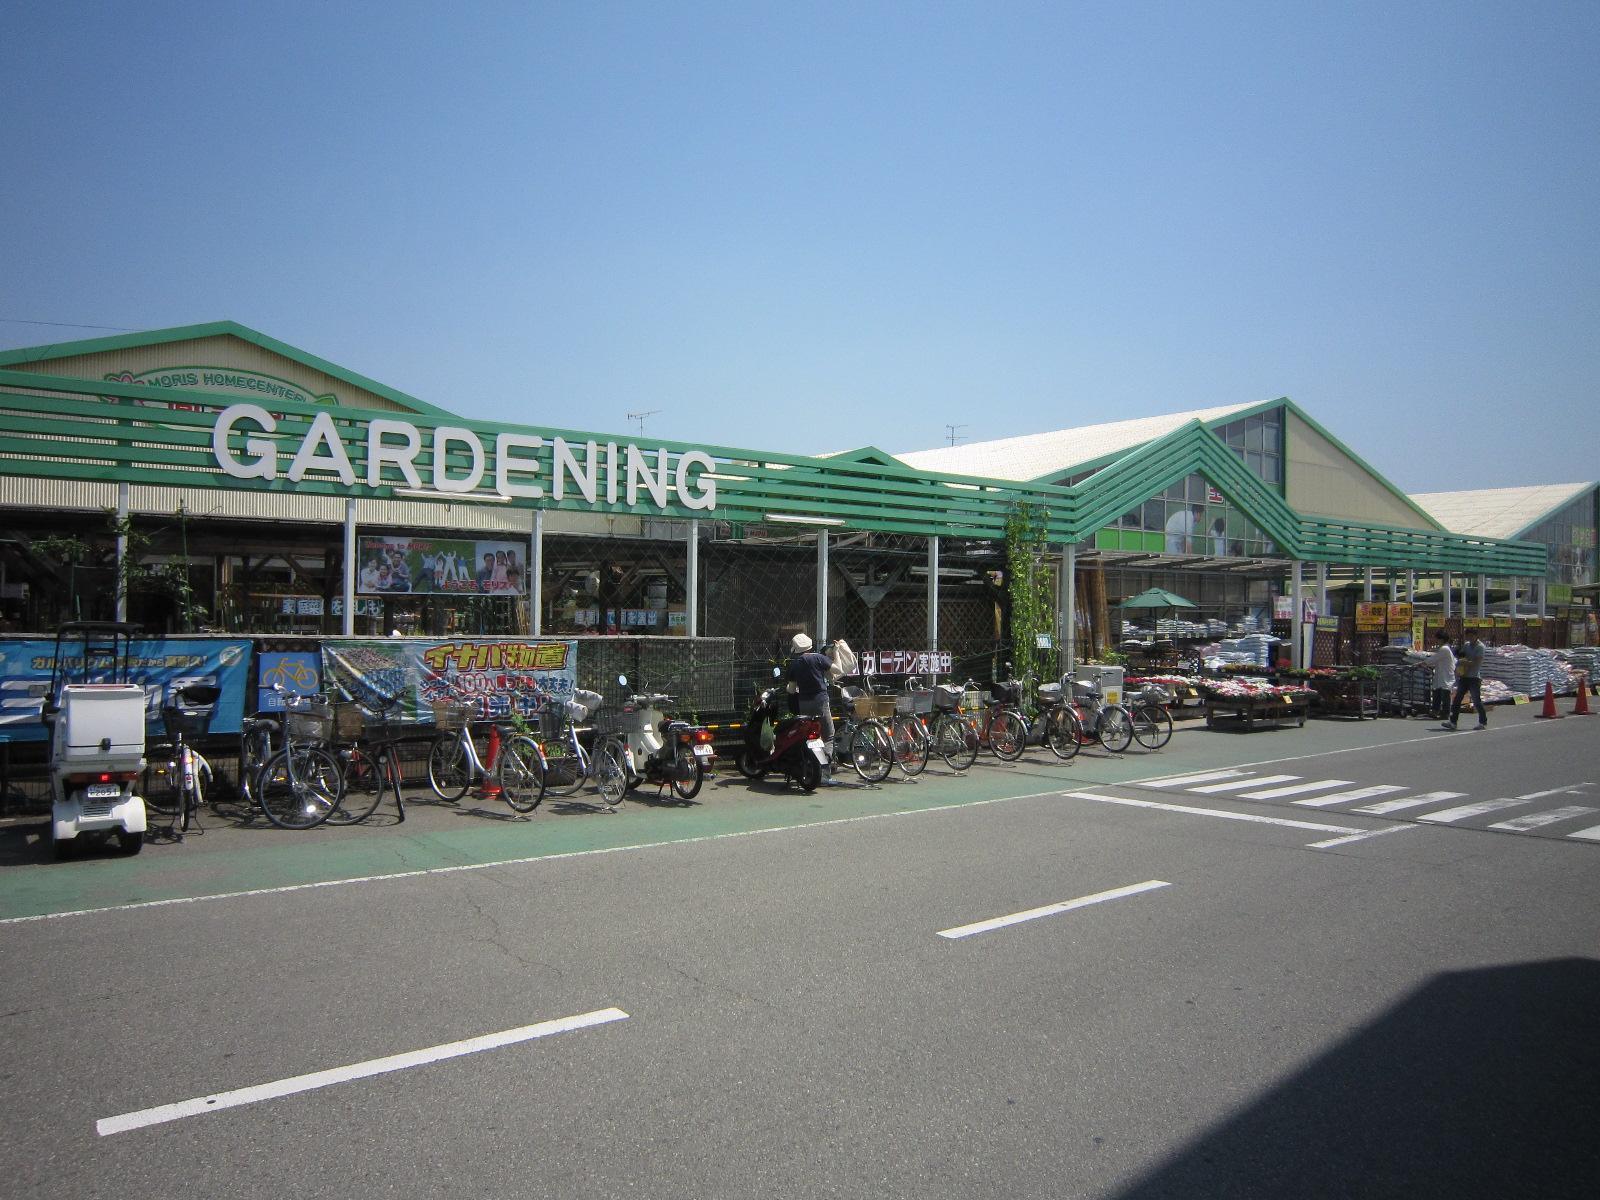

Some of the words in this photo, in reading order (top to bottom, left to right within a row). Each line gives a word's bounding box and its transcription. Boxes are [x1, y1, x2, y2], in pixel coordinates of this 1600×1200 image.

[148, 372, 198, 388] MORIS
[203, 373, 306, 402] HOMECENTER
[213, 403, 716, 511] GARDENING
[425, 642, 568, 671] イナバ物置
[852, 652, 951, 674] カーテン実施中
